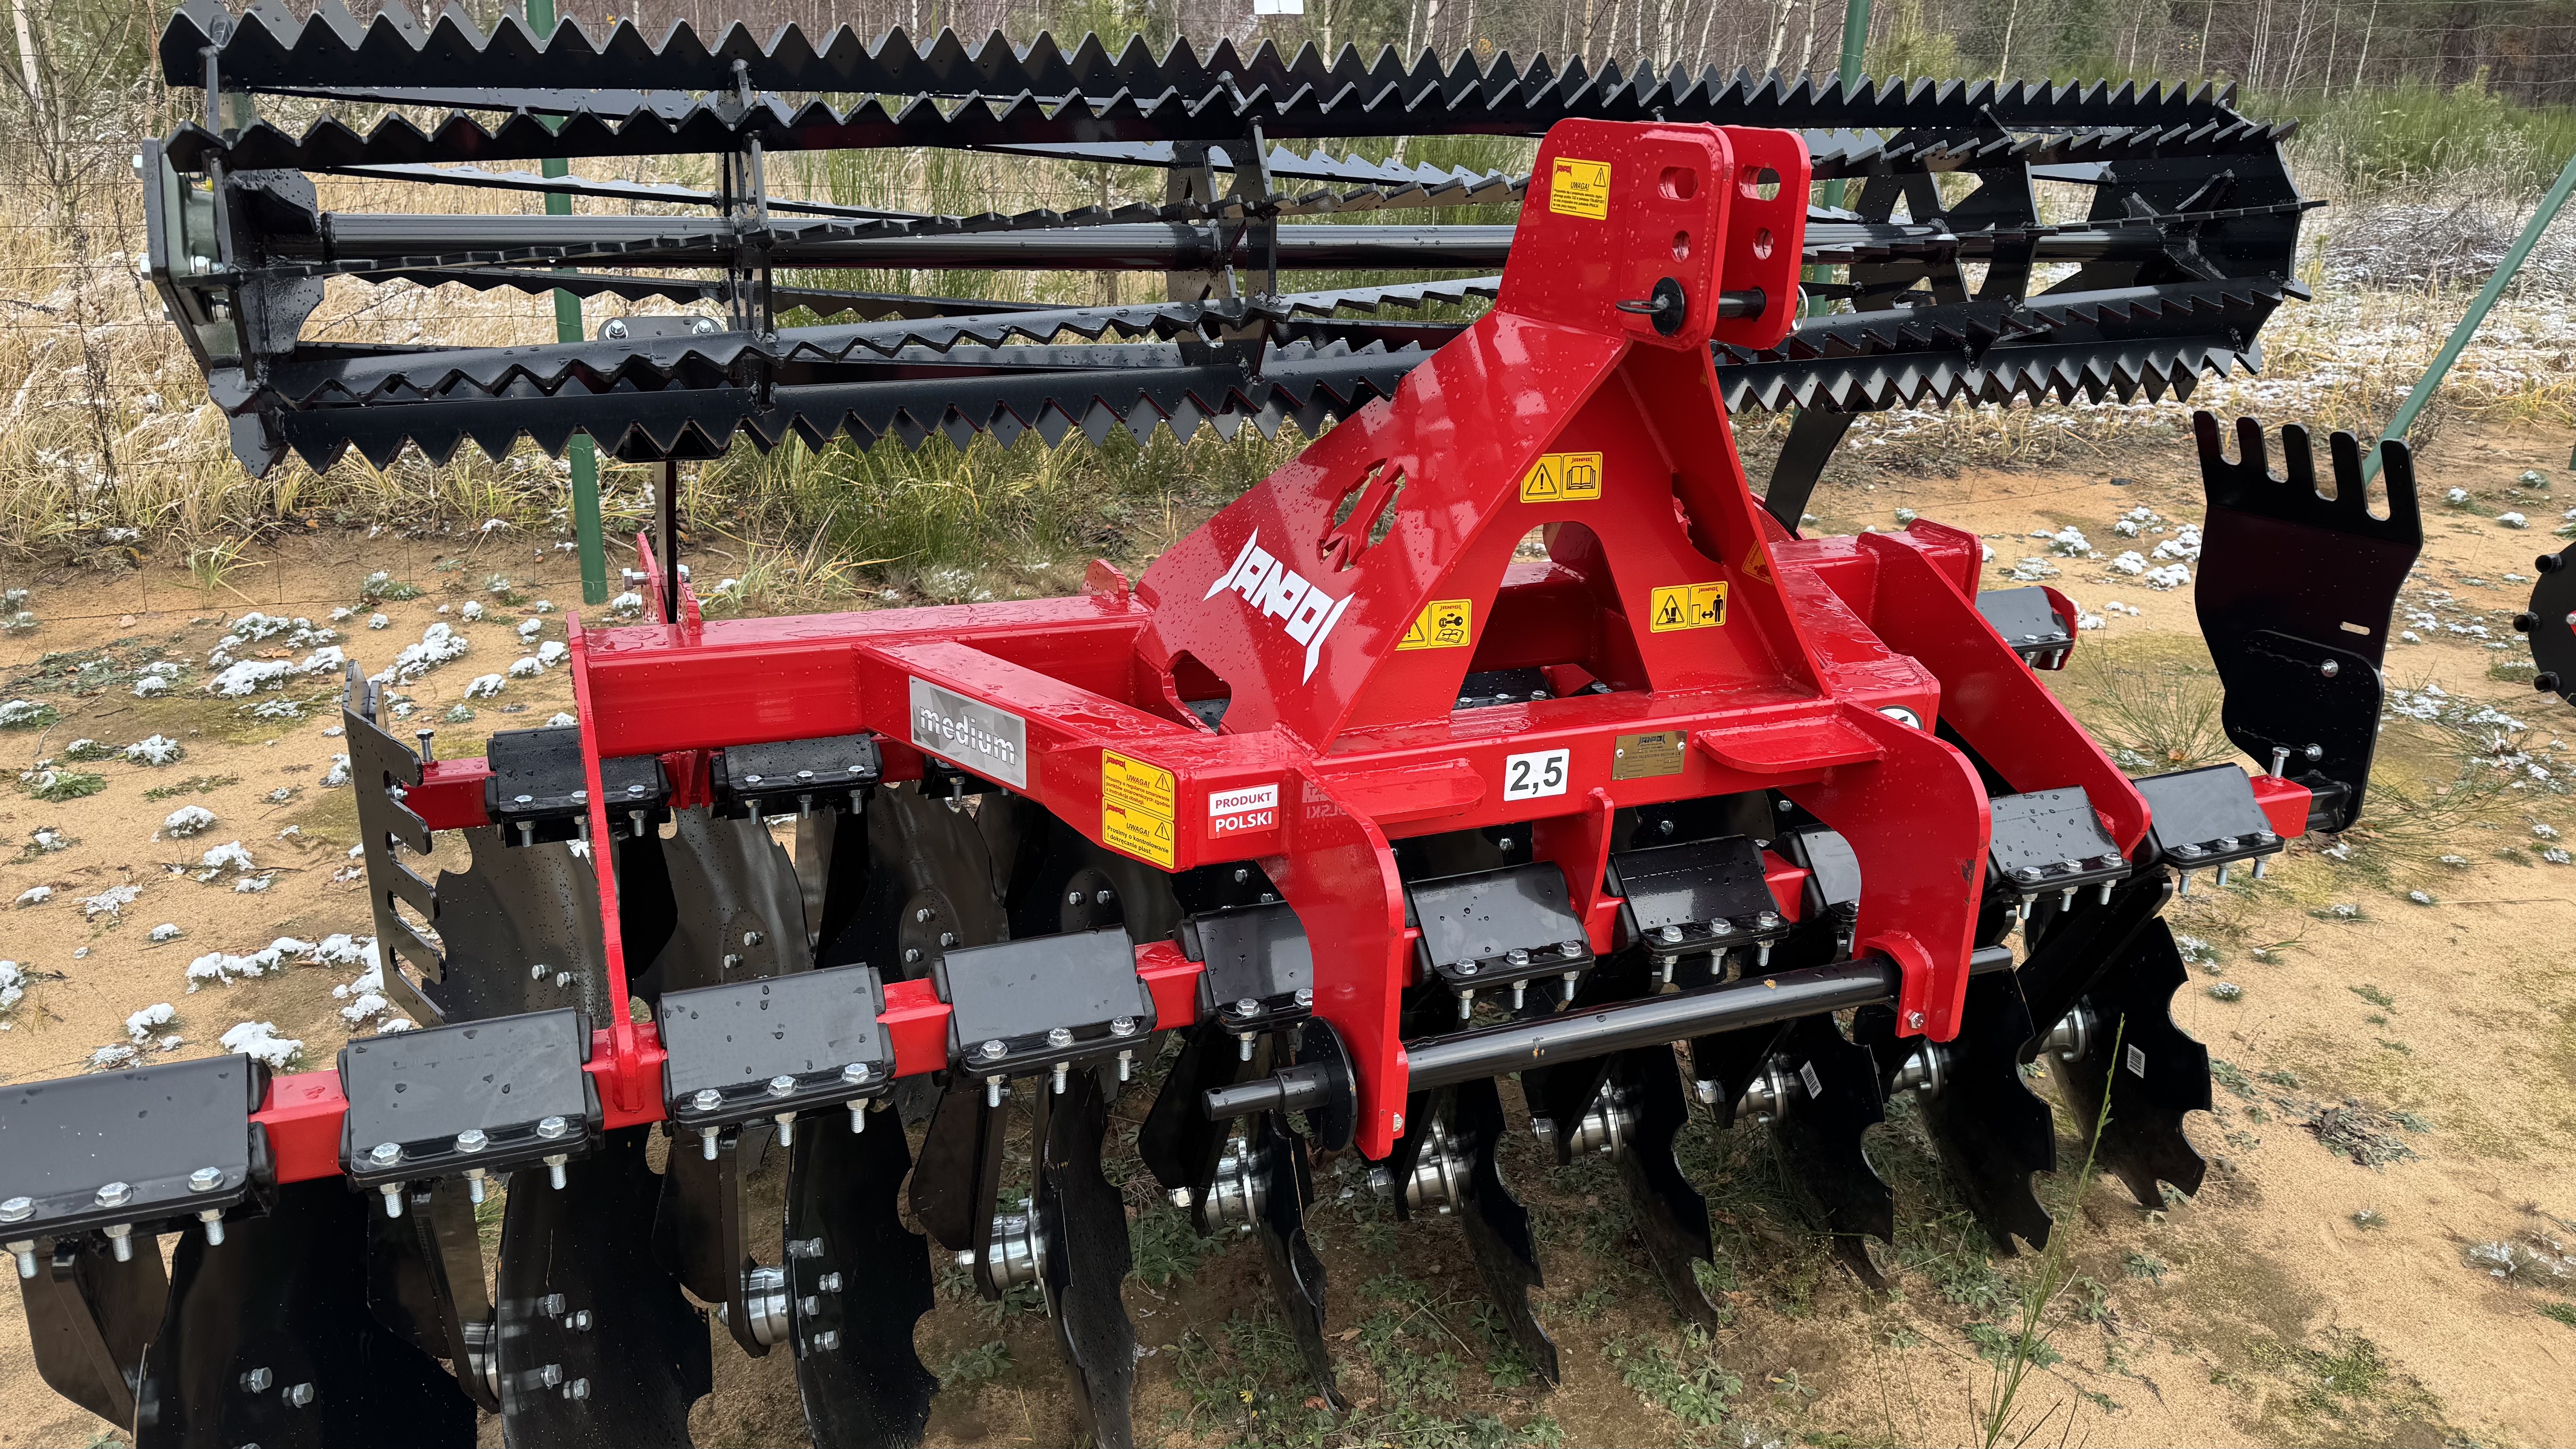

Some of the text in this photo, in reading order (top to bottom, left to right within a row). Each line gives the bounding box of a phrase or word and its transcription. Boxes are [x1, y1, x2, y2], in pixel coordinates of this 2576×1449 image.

[1570, 181, 1590, 190] UWAGA!
[919, 706, 1016, 766] medium
[1106, 775, 1122, 785] Prosimy
[1127, 774, 1150, 787] UWAGA!
[1510, 756, 1562, 795] 2,5
[1215, 791, 1272, 809] PRODUKT
[1126, 823, 1150, 836] UWAGA!
[1215, 811, 1272, 833] POLSKI
[1107, 825, 1127, 838] Prosimy
[1133, 835, 1169, 854] kontrolowanie
